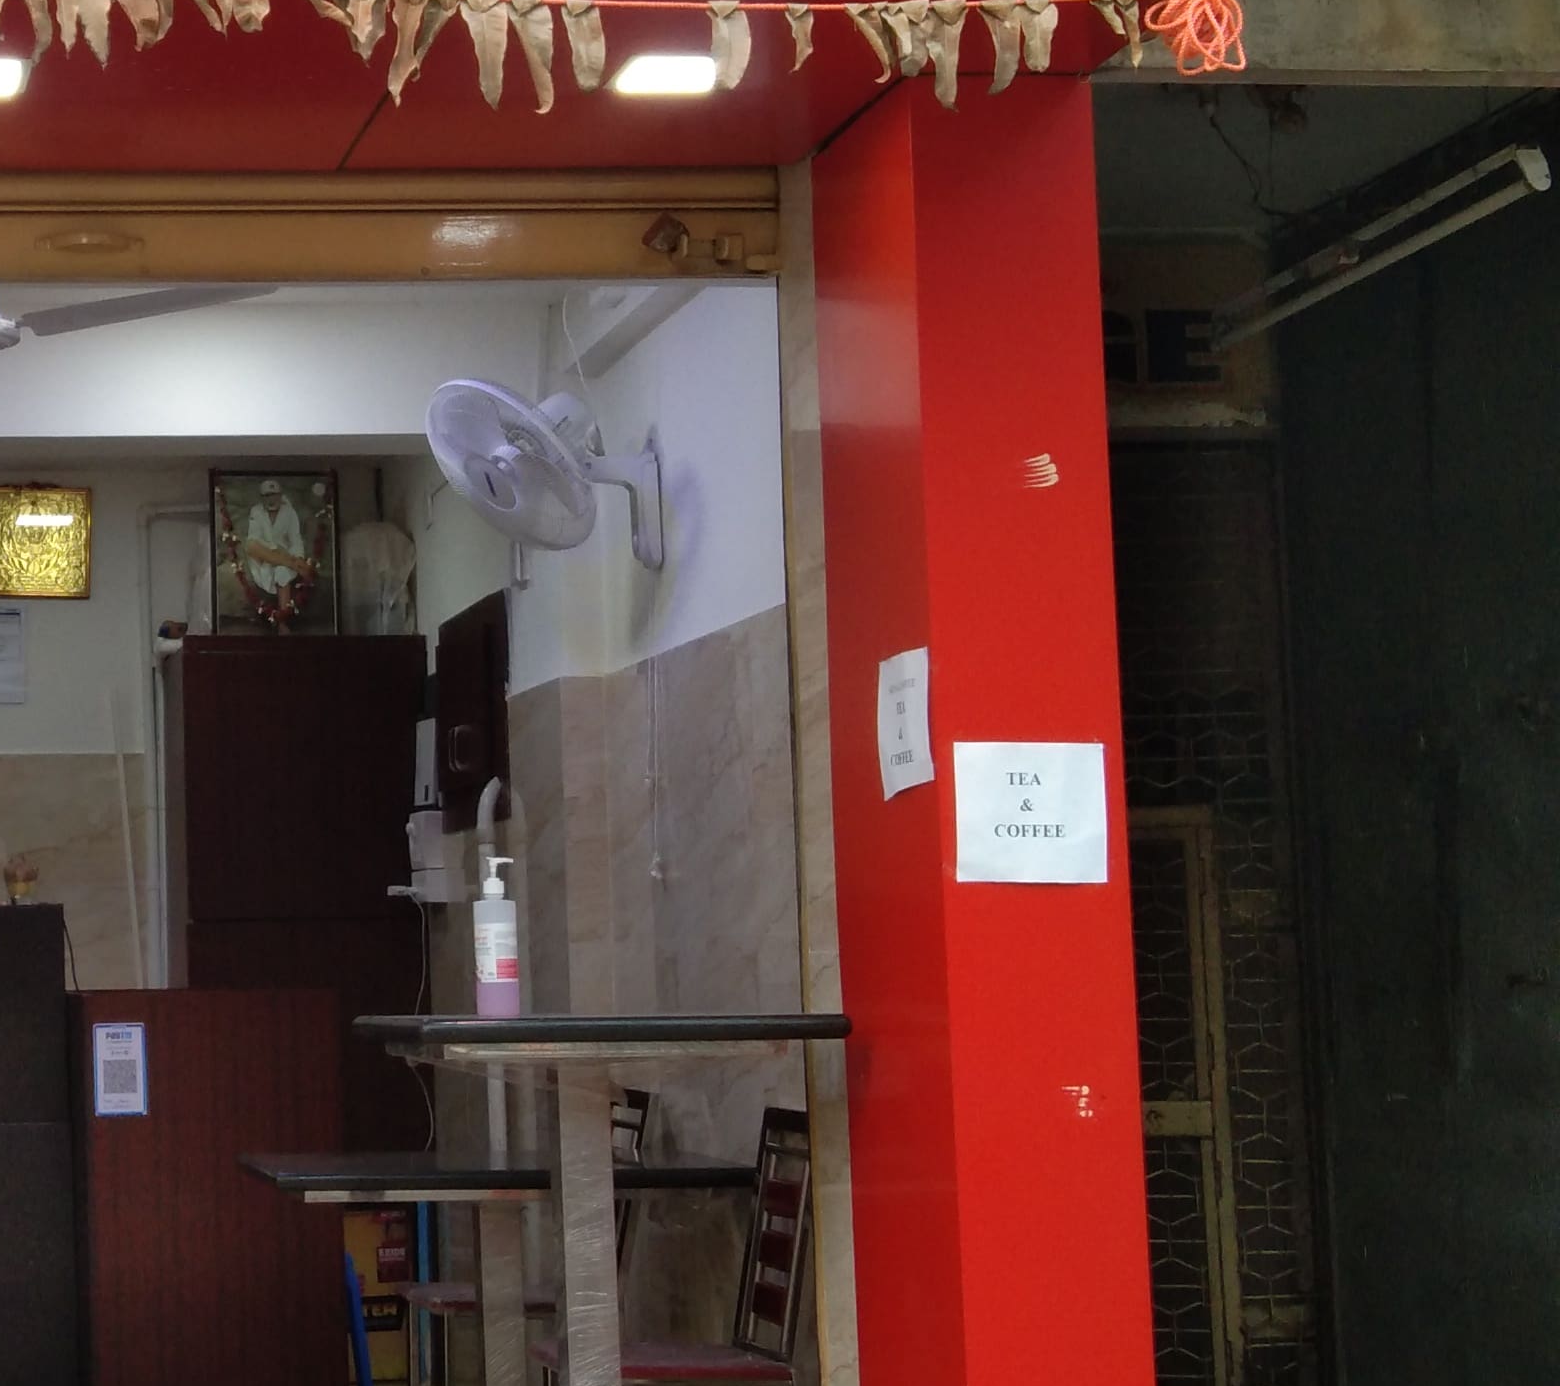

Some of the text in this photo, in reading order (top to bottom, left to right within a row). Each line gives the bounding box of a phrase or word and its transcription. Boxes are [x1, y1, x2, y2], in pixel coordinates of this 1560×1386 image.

[1006, 771, 1042, 787] TEA
[1019, 798, 1034, 813] &
[993, 823, 1067, 839] COFFEE
